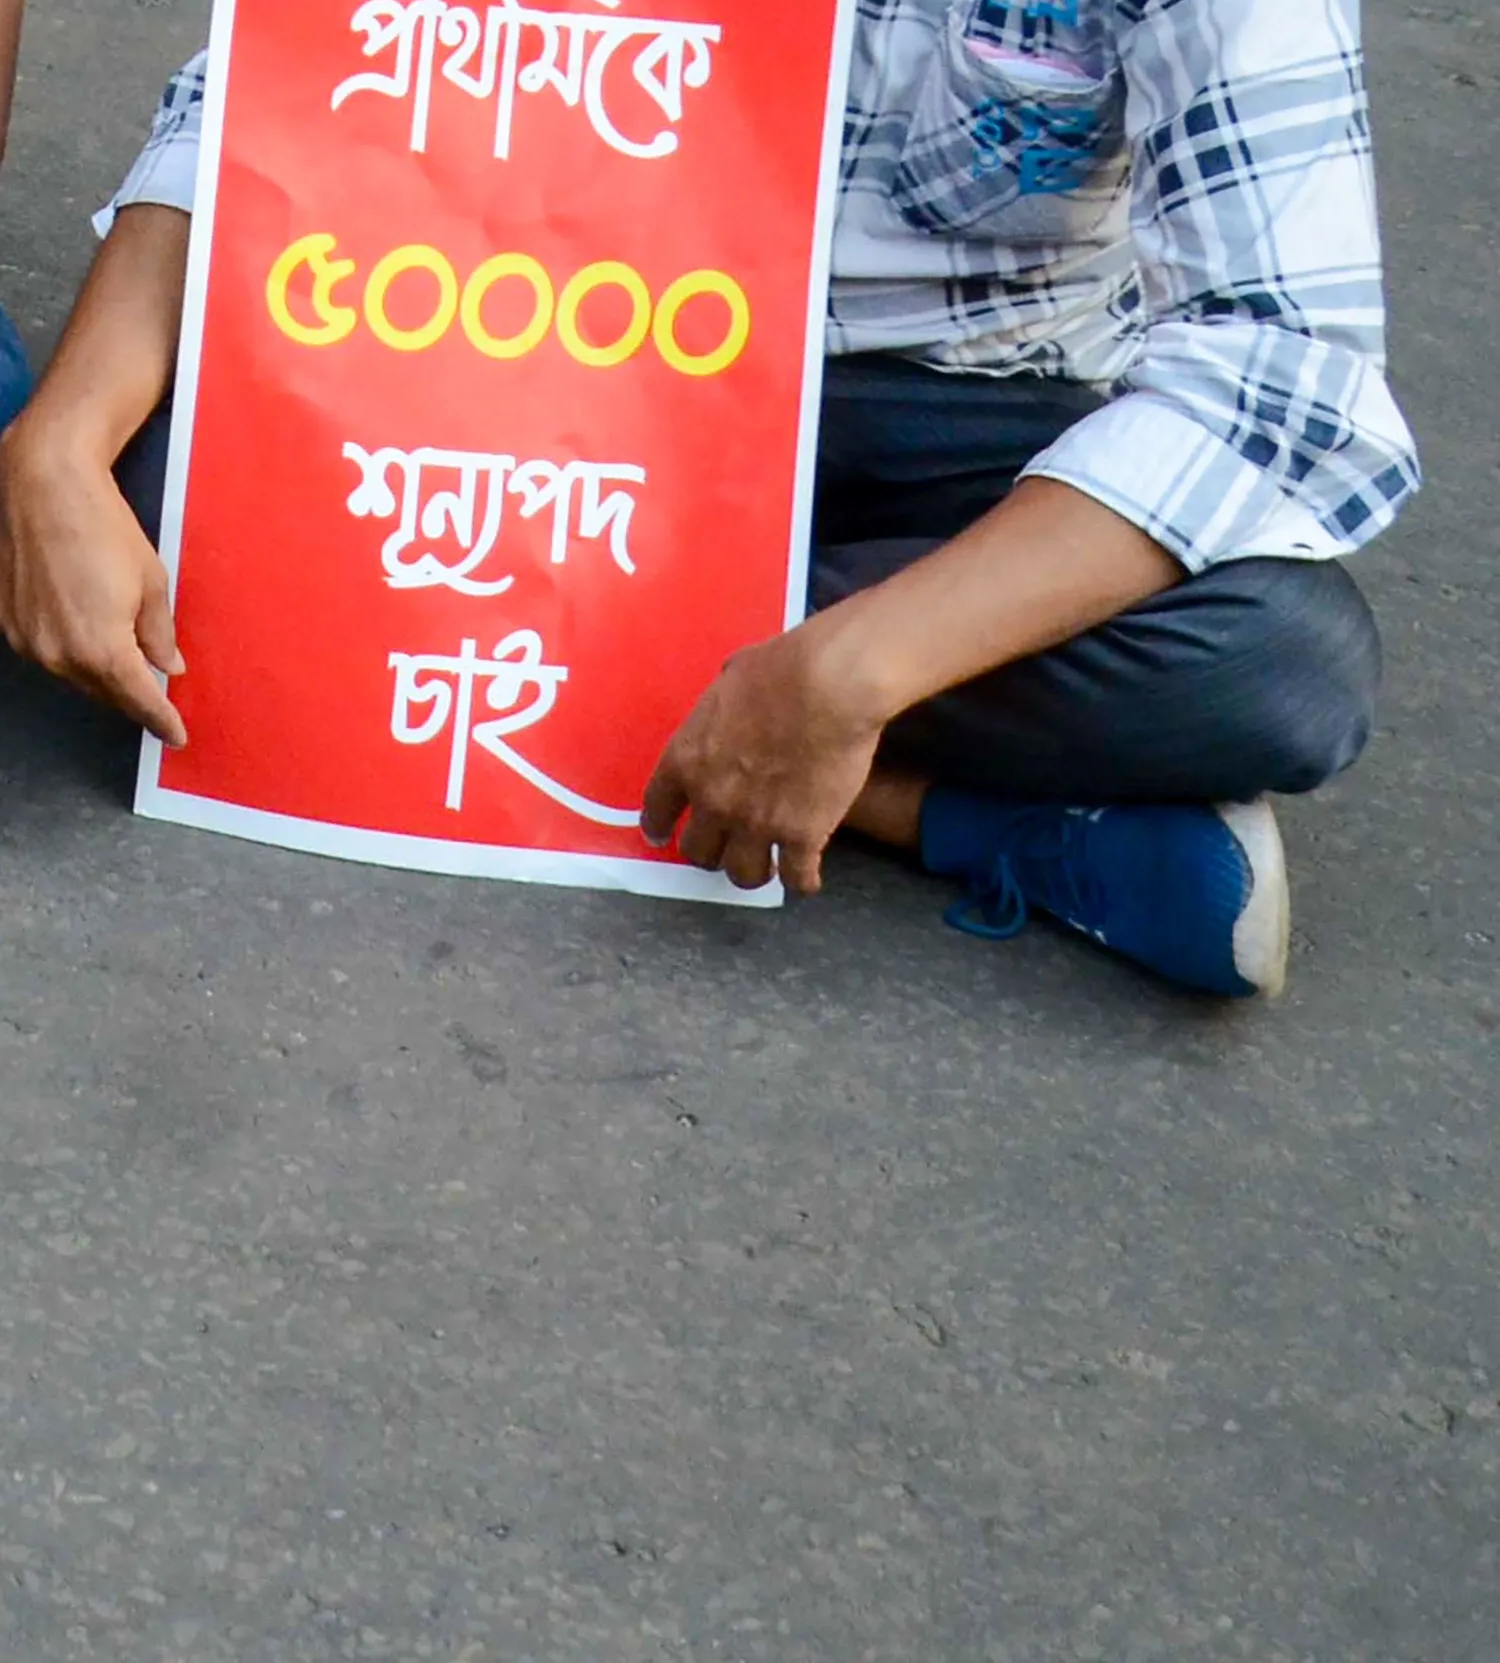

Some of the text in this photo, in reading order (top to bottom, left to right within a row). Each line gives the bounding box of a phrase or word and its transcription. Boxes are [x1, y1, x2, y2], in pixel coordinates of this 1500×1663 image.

[266, 233, 749, 376] ৫০০০০
[343, 442, 645, 596] শূন্যপদ
[388, 630, 640, 825] চাই
